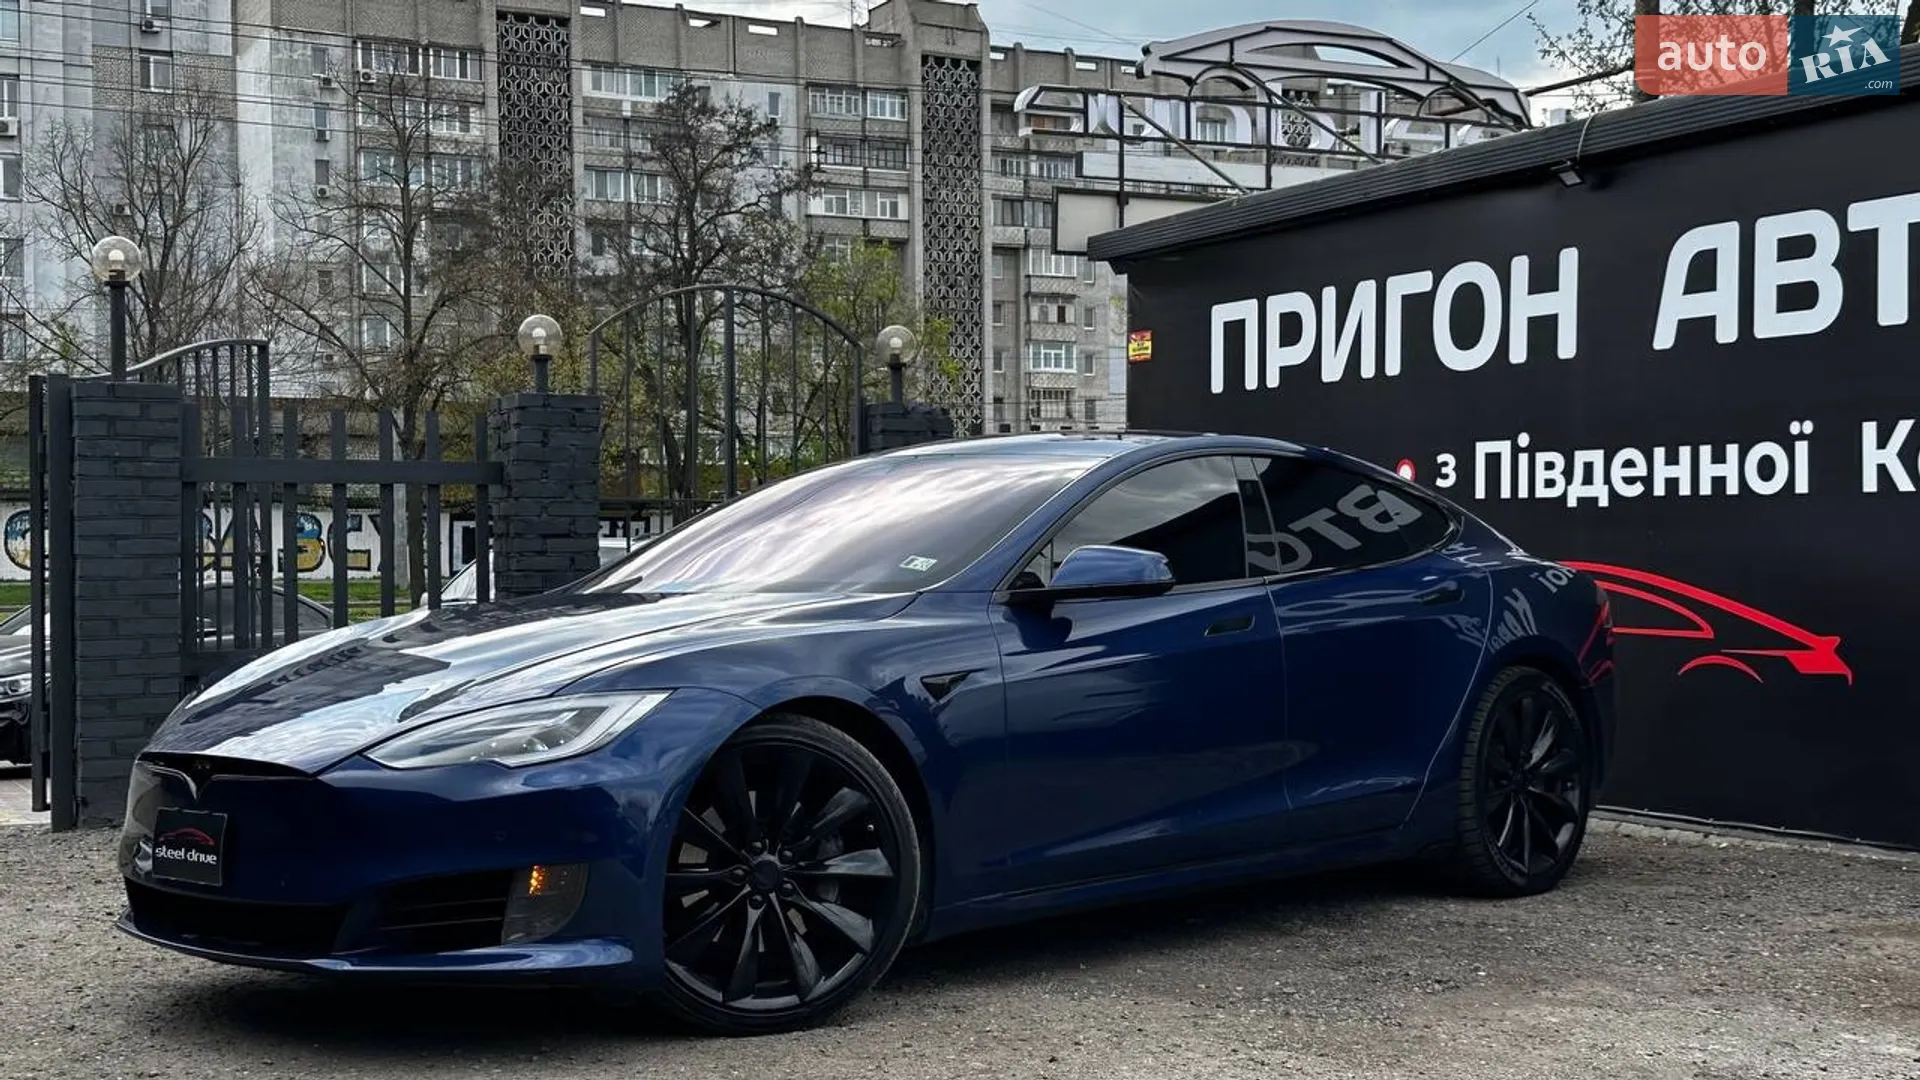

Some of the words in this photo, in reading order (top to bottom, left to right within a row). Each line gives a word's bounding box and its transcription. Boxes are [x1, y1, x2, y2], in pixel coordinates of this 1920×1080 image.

[1210, 246, 1580, 395] ПРИГОН
[1652, 191, 1920, 351] АВТ
[1434, 452, 1457, 488] з
[1474, 419, 1815, 508] Південної
[1861, 418, 1920, 493] К
[155, 845, 185, 859] steel
[186, 849, 217, 865] drive
